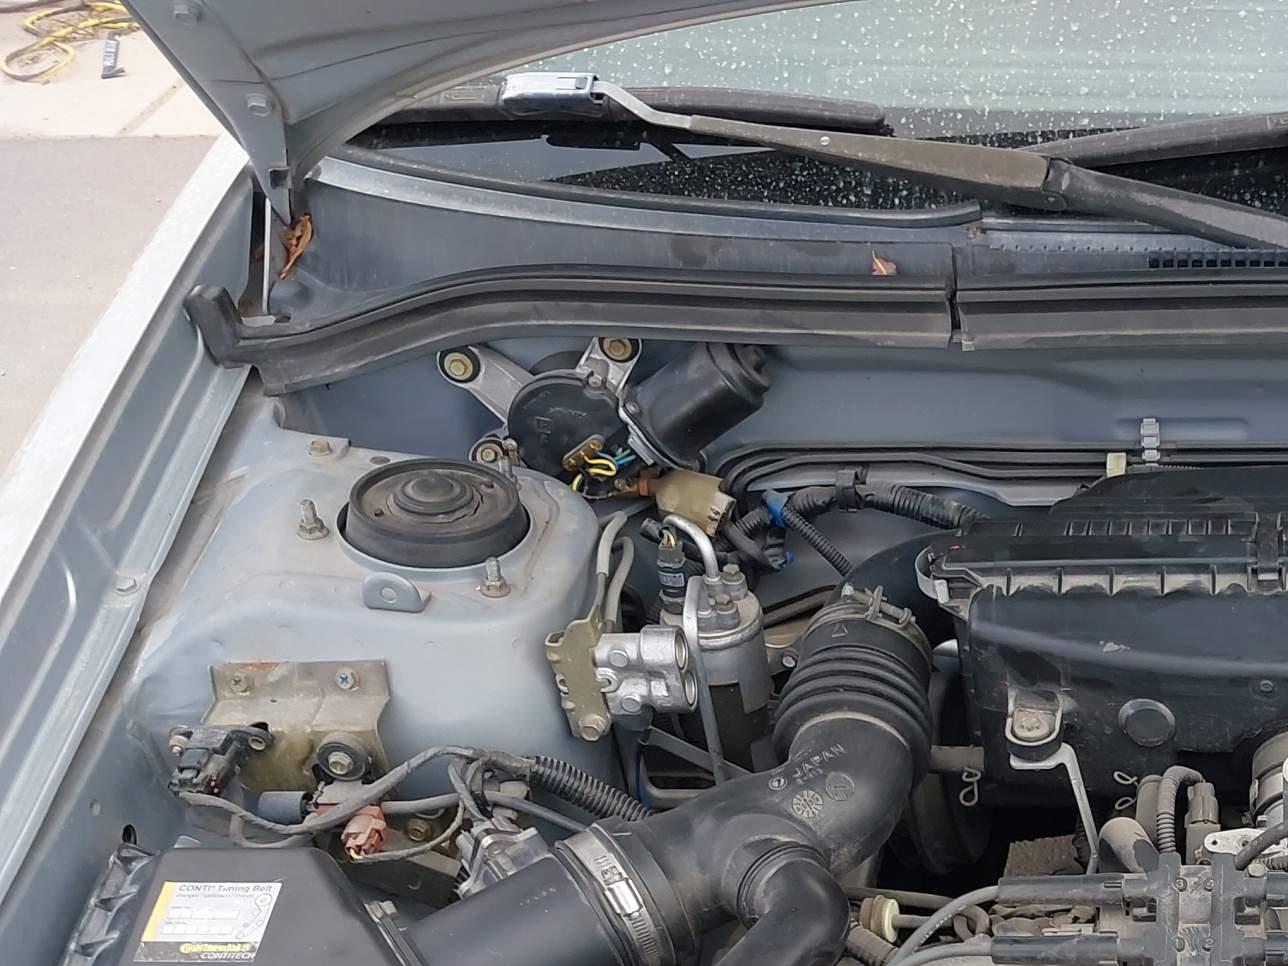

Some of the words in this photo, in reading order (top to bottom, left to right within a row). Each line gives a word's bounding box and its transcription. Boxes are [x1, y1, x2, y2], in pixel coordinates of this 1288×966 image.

[792, 744, 848, 776] JAPAN
[218, 885, 249, 893] Timing
[252, 884, 273, 892] Belt
[199, 952, 256, 960] CONTITECH
